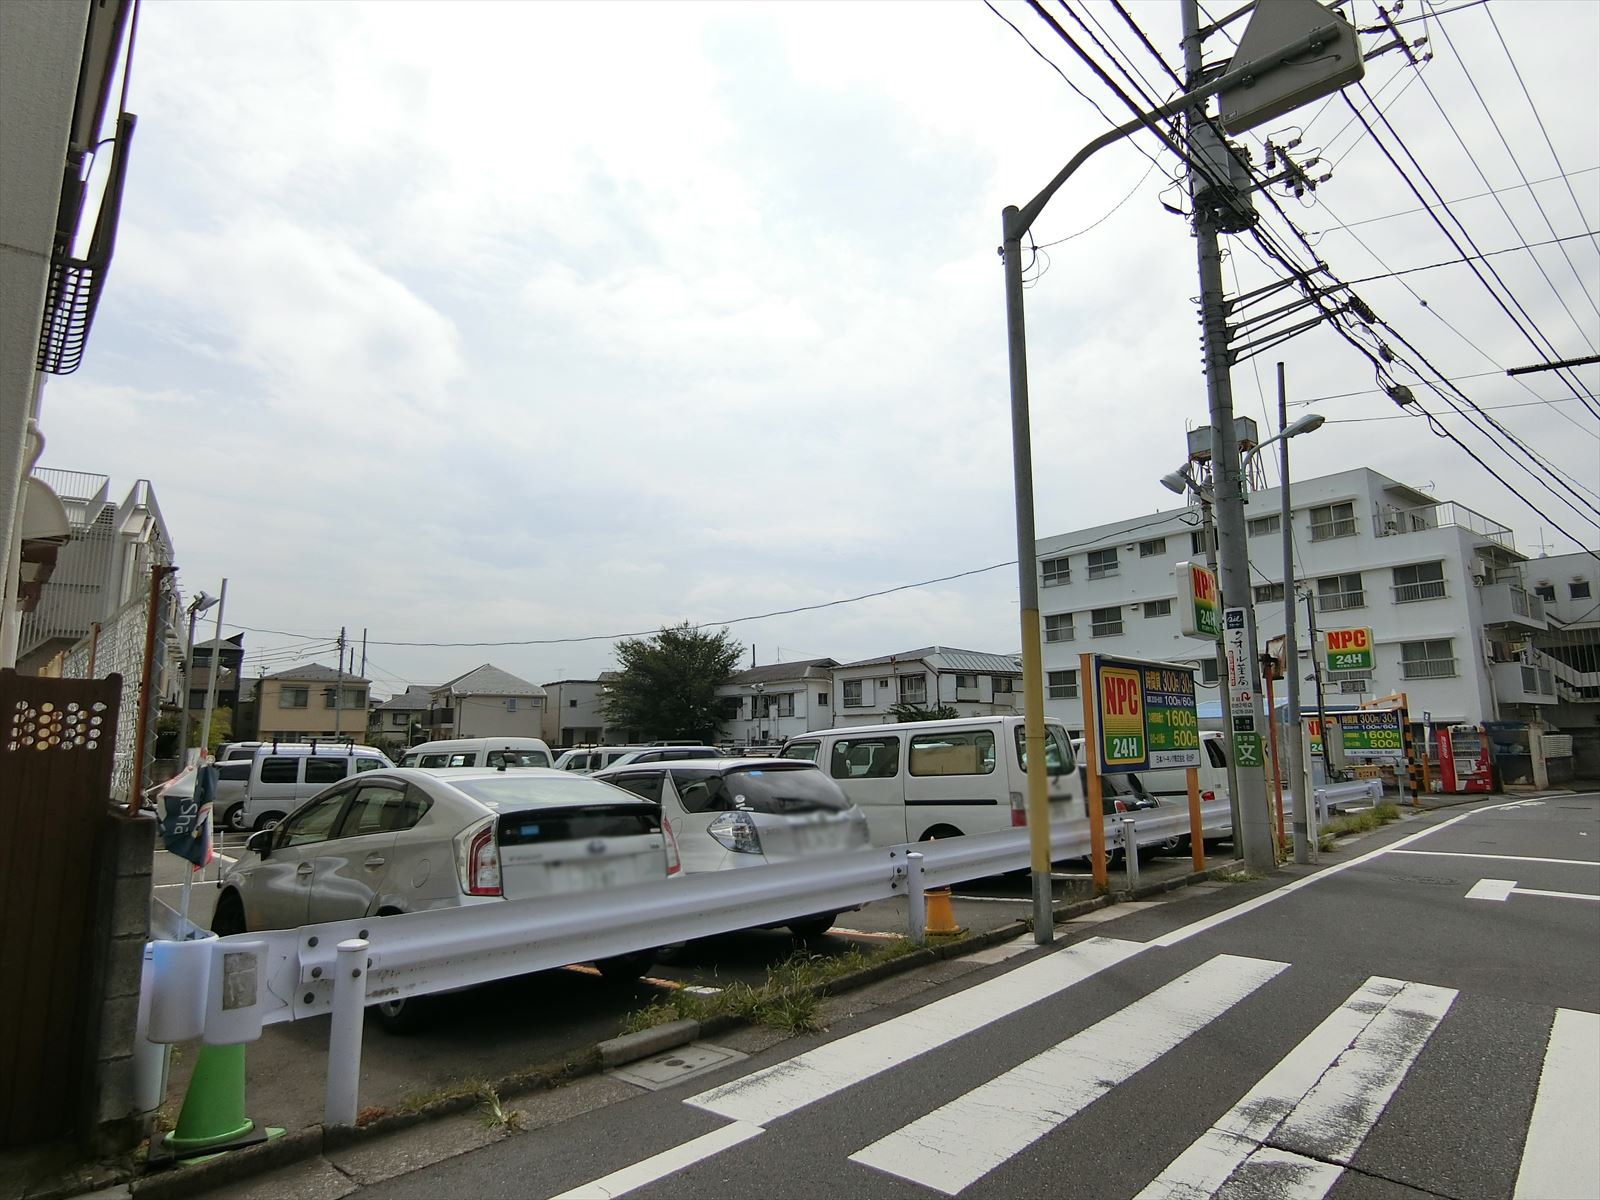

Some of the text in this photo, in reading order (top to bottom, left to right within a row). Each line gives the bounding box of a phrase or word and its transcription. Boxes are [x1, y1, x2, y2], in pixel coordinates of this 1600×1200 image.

[1193, 567, 1216, 602] NPC
[1200, 609, 1217, 626] 24H
[1327, 629, 1366, 650] NPC
[1335, 653, 1362, 665] 24H
[1104, 676, 1138, 716] NPC
[1165, 709, 1197, 727] 1600円
[1173, 730, 1198, 747] 500円
[1361, 730, 1399, 739] 1600円
[1113, 736, 1138, 759] 24H
[1238, 742, 1257, 761] 文
[1311, 743, 1323, 752] 24
[1370, 739, 1400, 748] 500円
